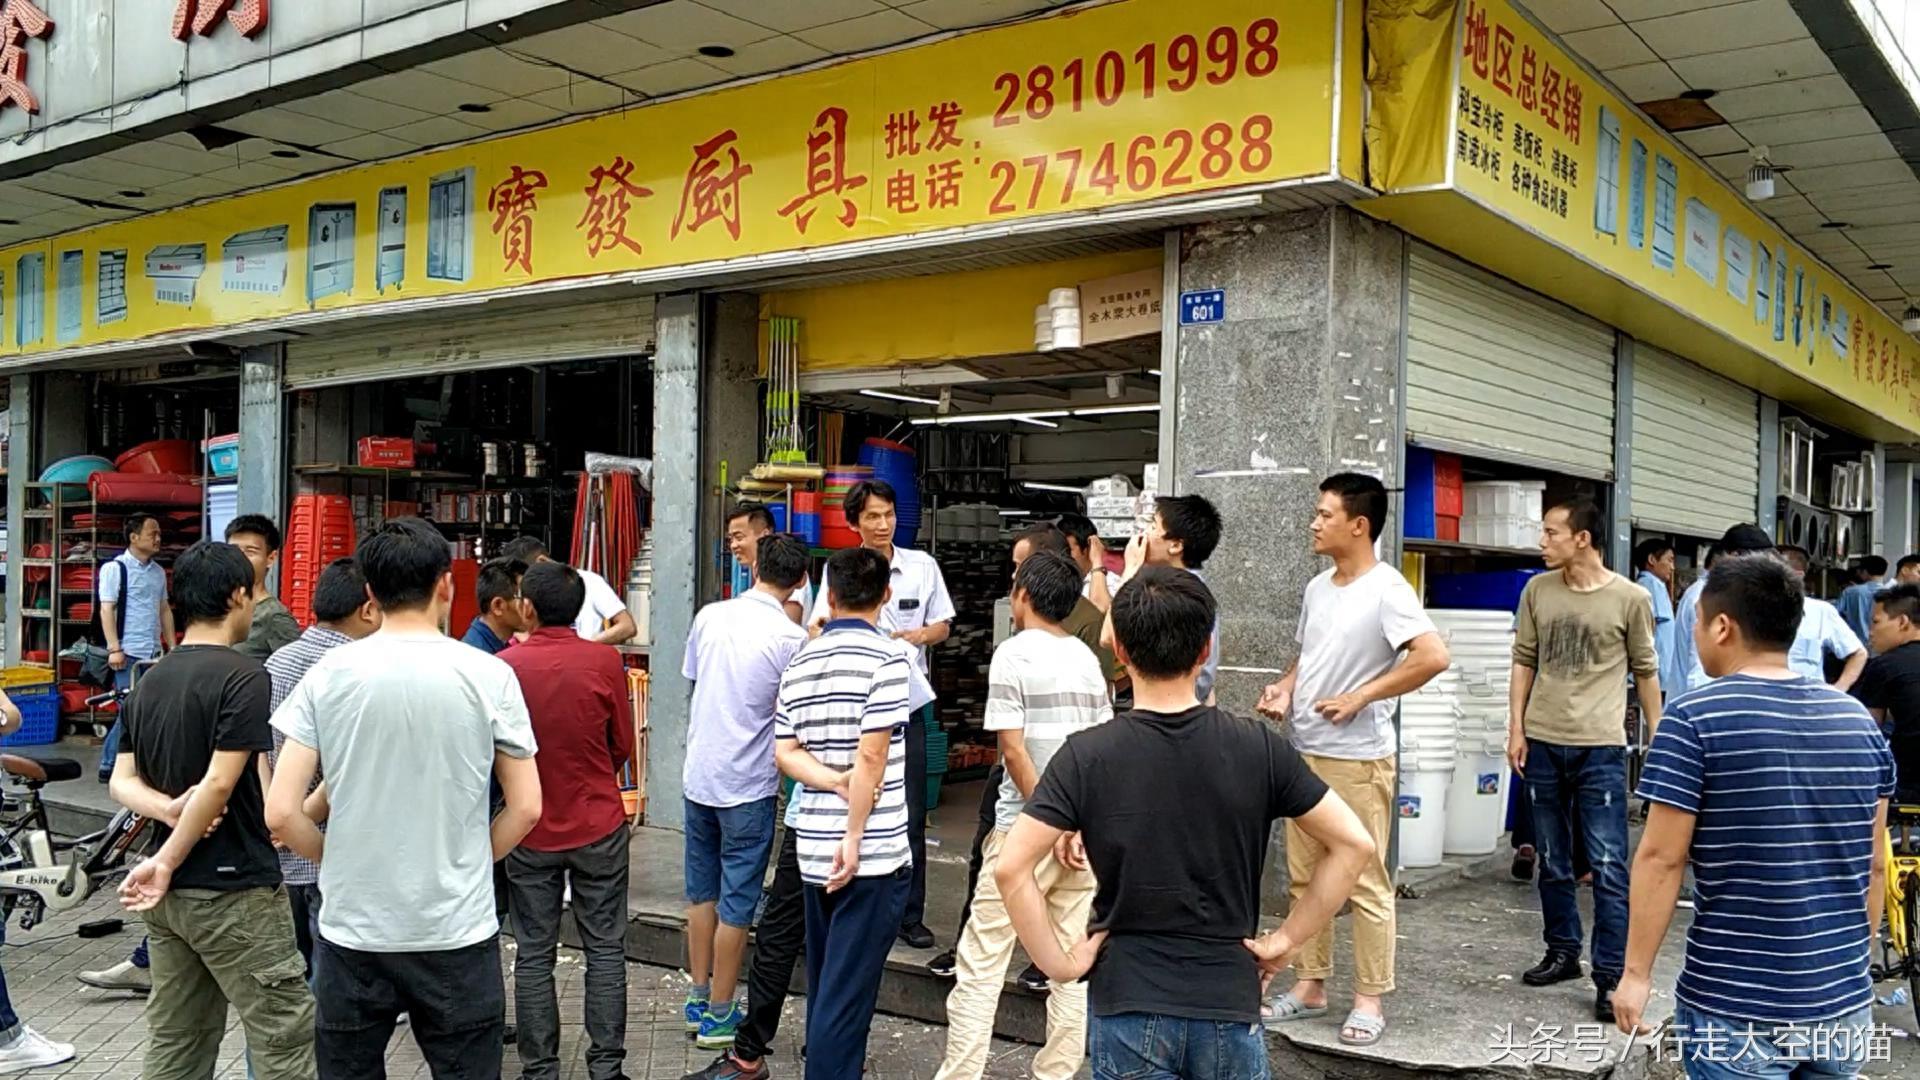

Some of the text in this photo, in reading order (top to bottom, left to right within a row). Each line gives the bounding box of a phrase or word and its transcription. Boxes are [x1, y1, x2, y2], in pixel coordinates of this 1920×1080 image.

[992, 17, 1280, 129] 28101998
[1464, 0, 1583, 145] 地区总经销
[884, 101, 963, 160] 批发
[884, 159, 963, 214] 电话
[988, 114, 1274, 216] 27746288
[1512, 160, 1568, 219] 各种食品机器
[1192, 304, 1214, 321] 601
[16, 875, 58, 885] E-bike
